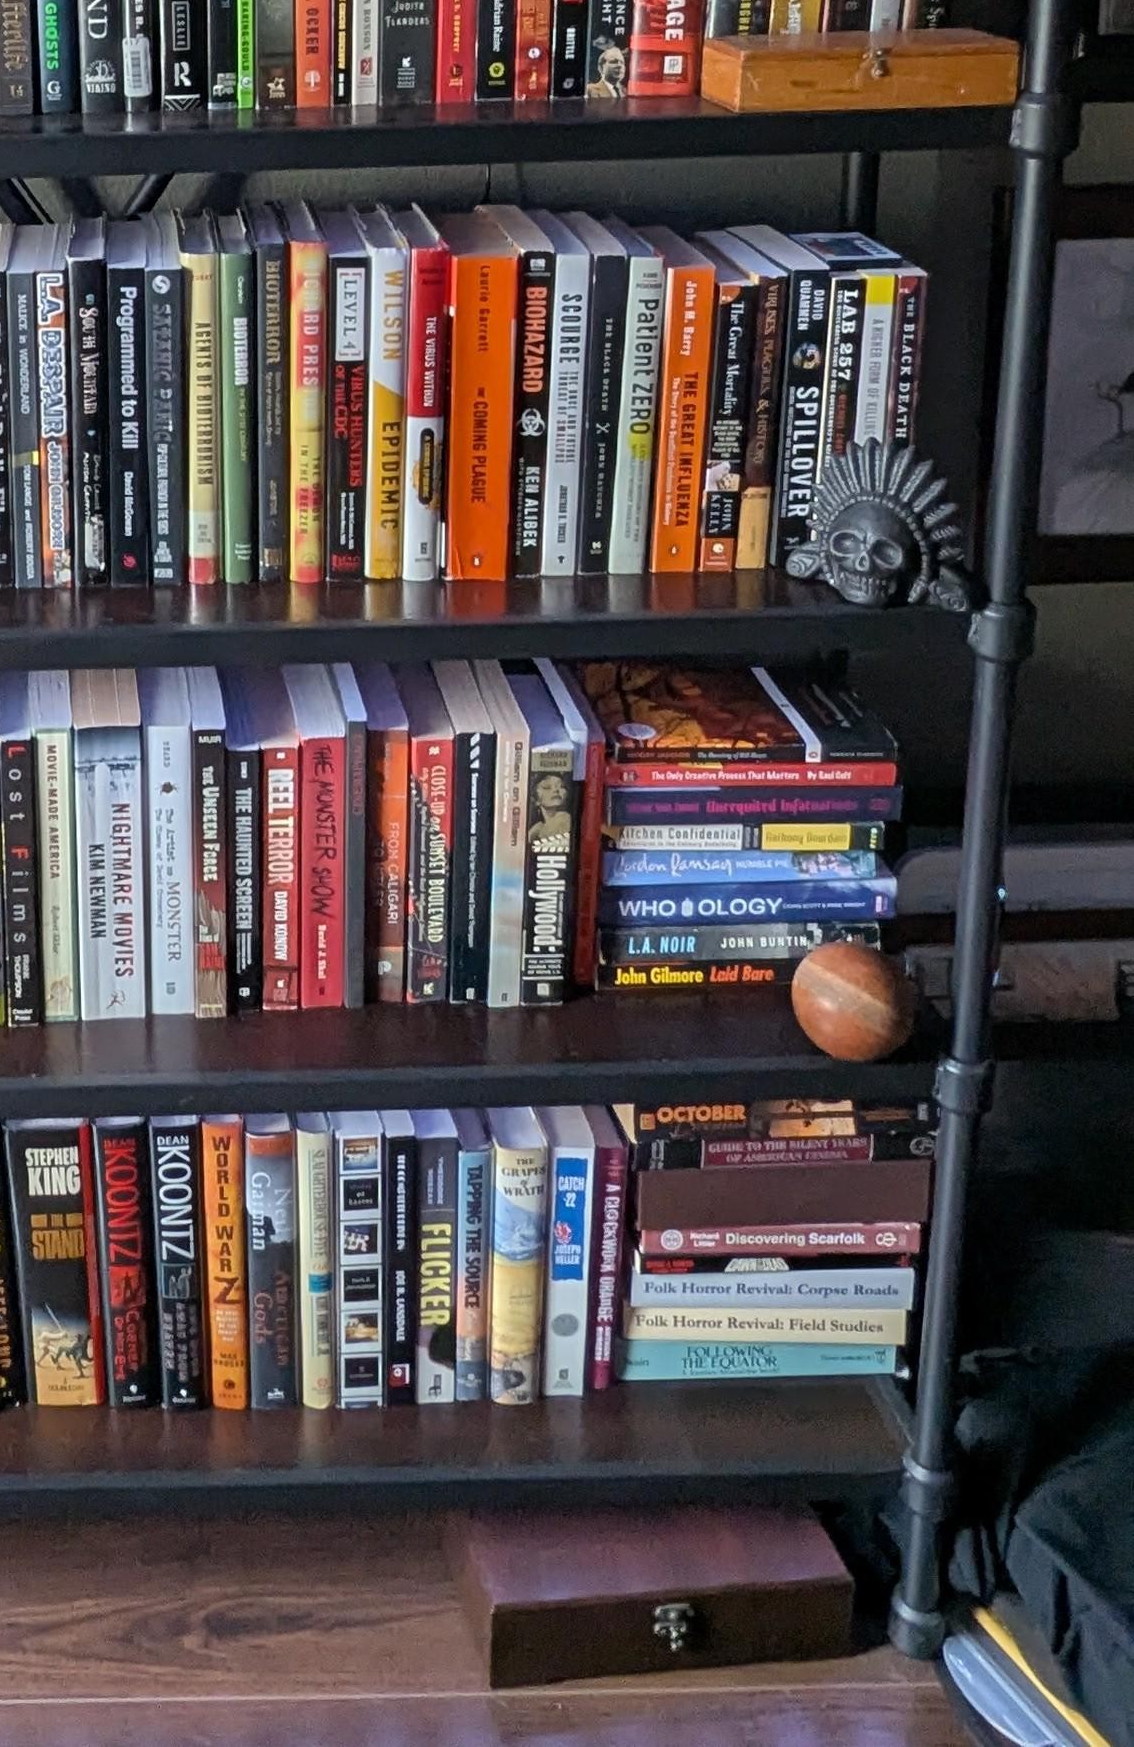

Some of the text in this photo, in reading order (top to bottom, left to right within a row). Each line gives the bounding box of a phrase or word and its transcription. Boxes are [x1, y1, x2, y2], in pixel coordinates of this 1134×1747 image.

[383, 269, 403, 361] WILSON
[522, 285, 548, 394] BIOHAZARD
[116, 286, 139, 450] Programmed Kill
[629, 298, 659, 435] Patient ZERO
[380, 421, 401, 530] EPIDEMIC
[675, 451, 694, 527] INFLUENZA
[787, 387, 818, 519] SPILLOVER
[667, 828, 741, 841] Confidential
[89, 844, 107, 939] KIM NEWMAN
[111, 804, 134, 978] NIGHTMARE MOVIES
[614, 966, 775, 985] John Gilmore Laid Bare
[628, 935, 696, 954] L.A. NOIR
[25, 1146, 78, 1165] STEPHEN
[656, 1105, 746, 1123] OCTOBER
[27, 1164, 81, 1196] KING
[157, 1145, 195, 1260] KOONTZ
[419, 1223, 453, 1326] FLICKER
[725, 1231, 865, 1246] Discovering Scarfolk
[644, 1282, 899, 1298] Folk Horror Revival: Corpse Roads
[789, 1318, 884, 1332] Field Studies
